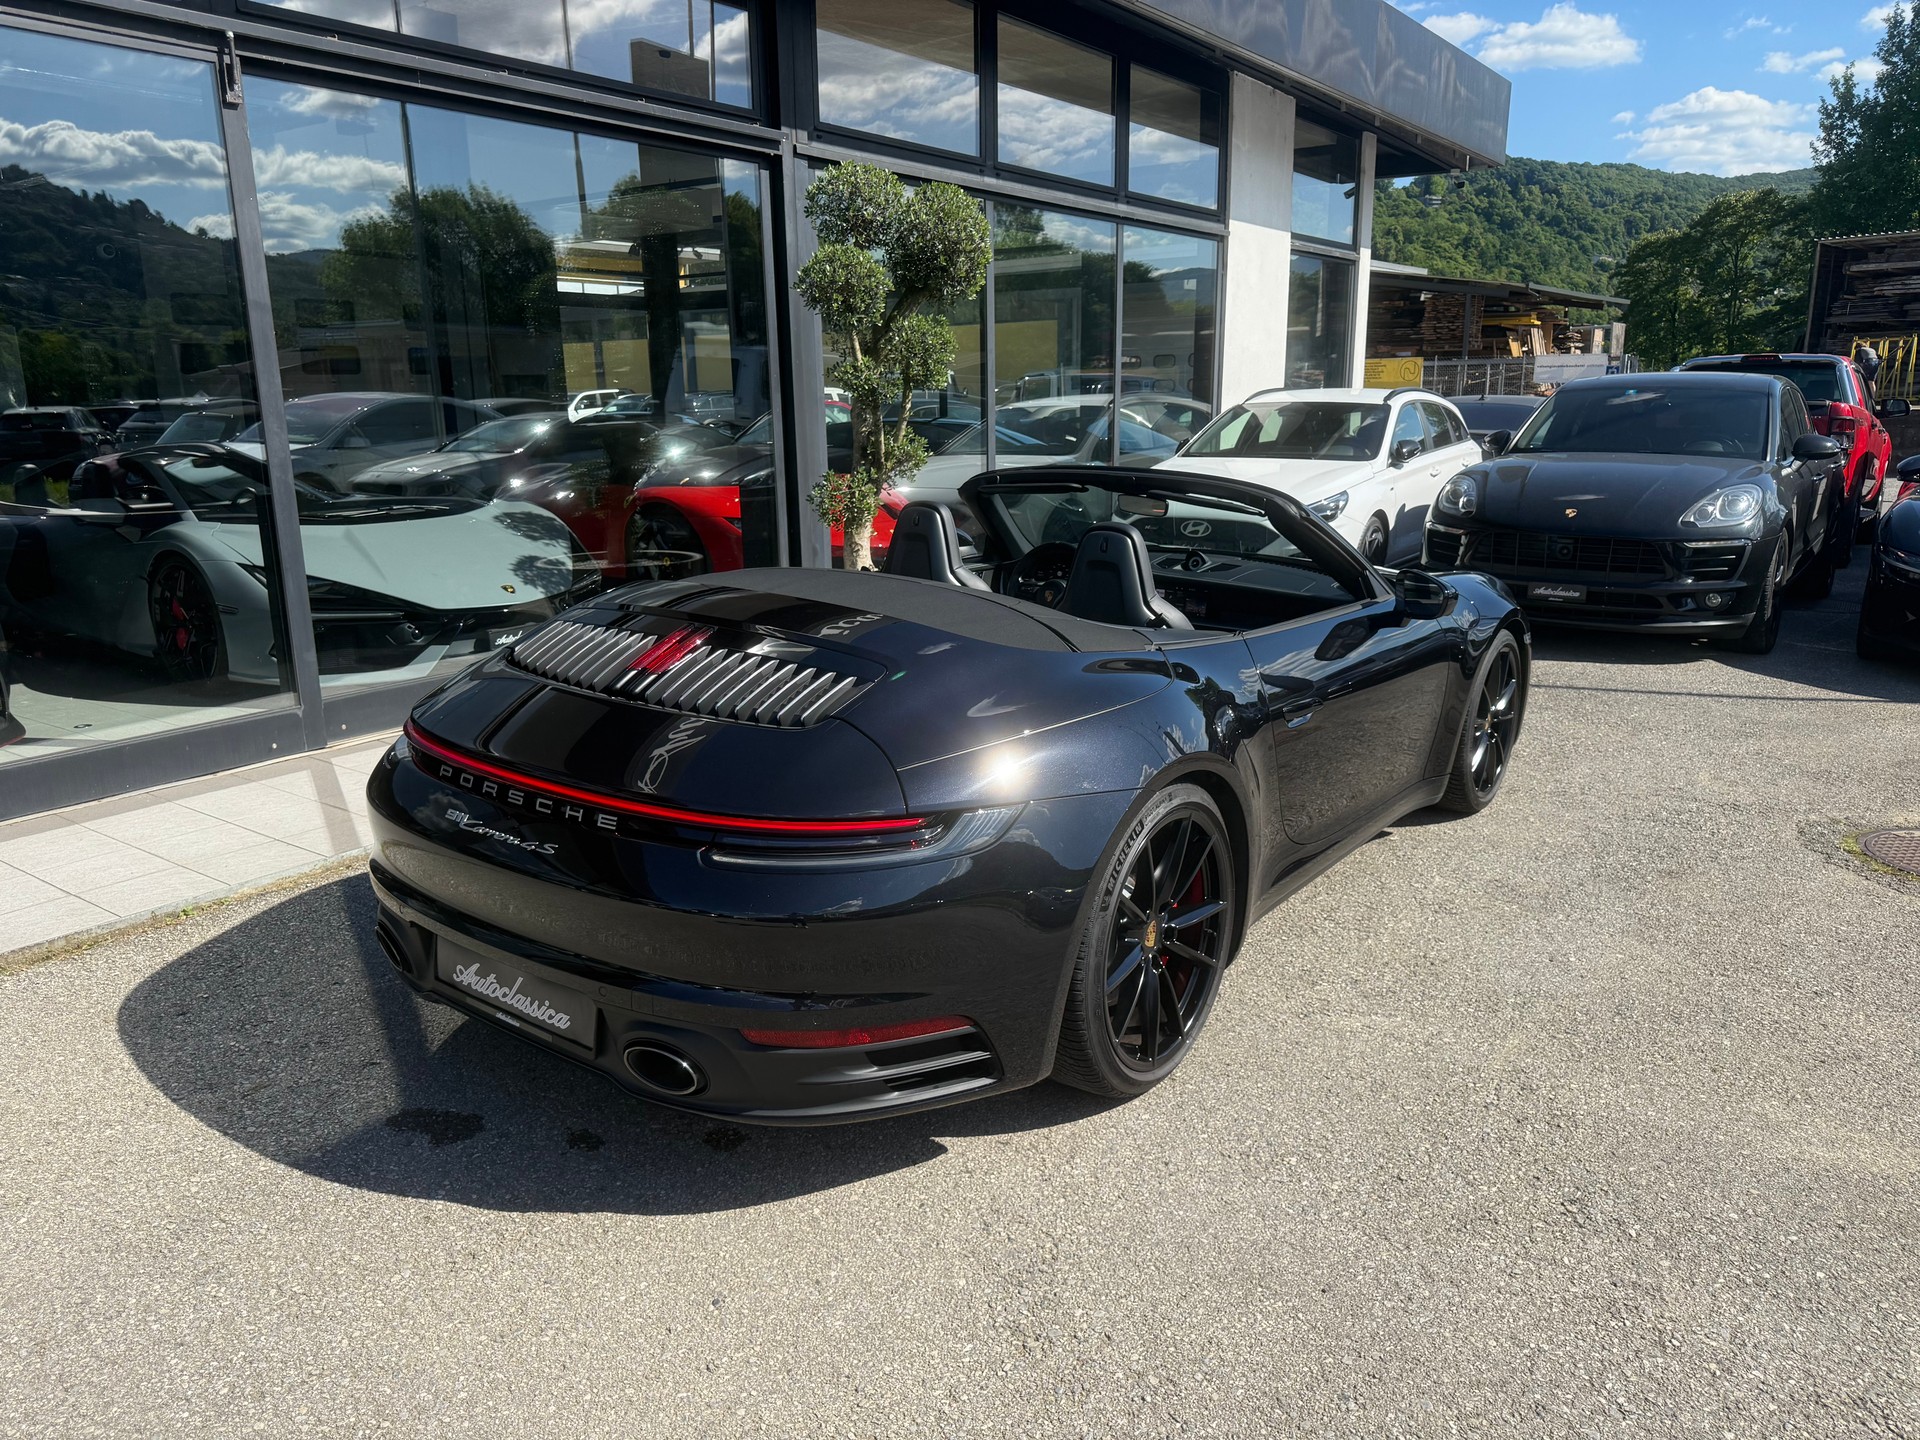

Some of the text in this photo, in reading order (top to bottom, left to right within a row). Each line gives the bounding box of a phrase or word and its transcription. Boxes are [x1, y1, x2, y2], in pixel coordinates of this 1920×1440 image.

[494, 630, 523, 646] Autocl
[440, 764, 618, 830] PORSCHE
[445, 808, 470, 824] 911
[459, 819, 521, 845] Carrera
[1107, 822, 1143, 892] MICHELIN
[452, 962, 571, 1030] Autoclassica
